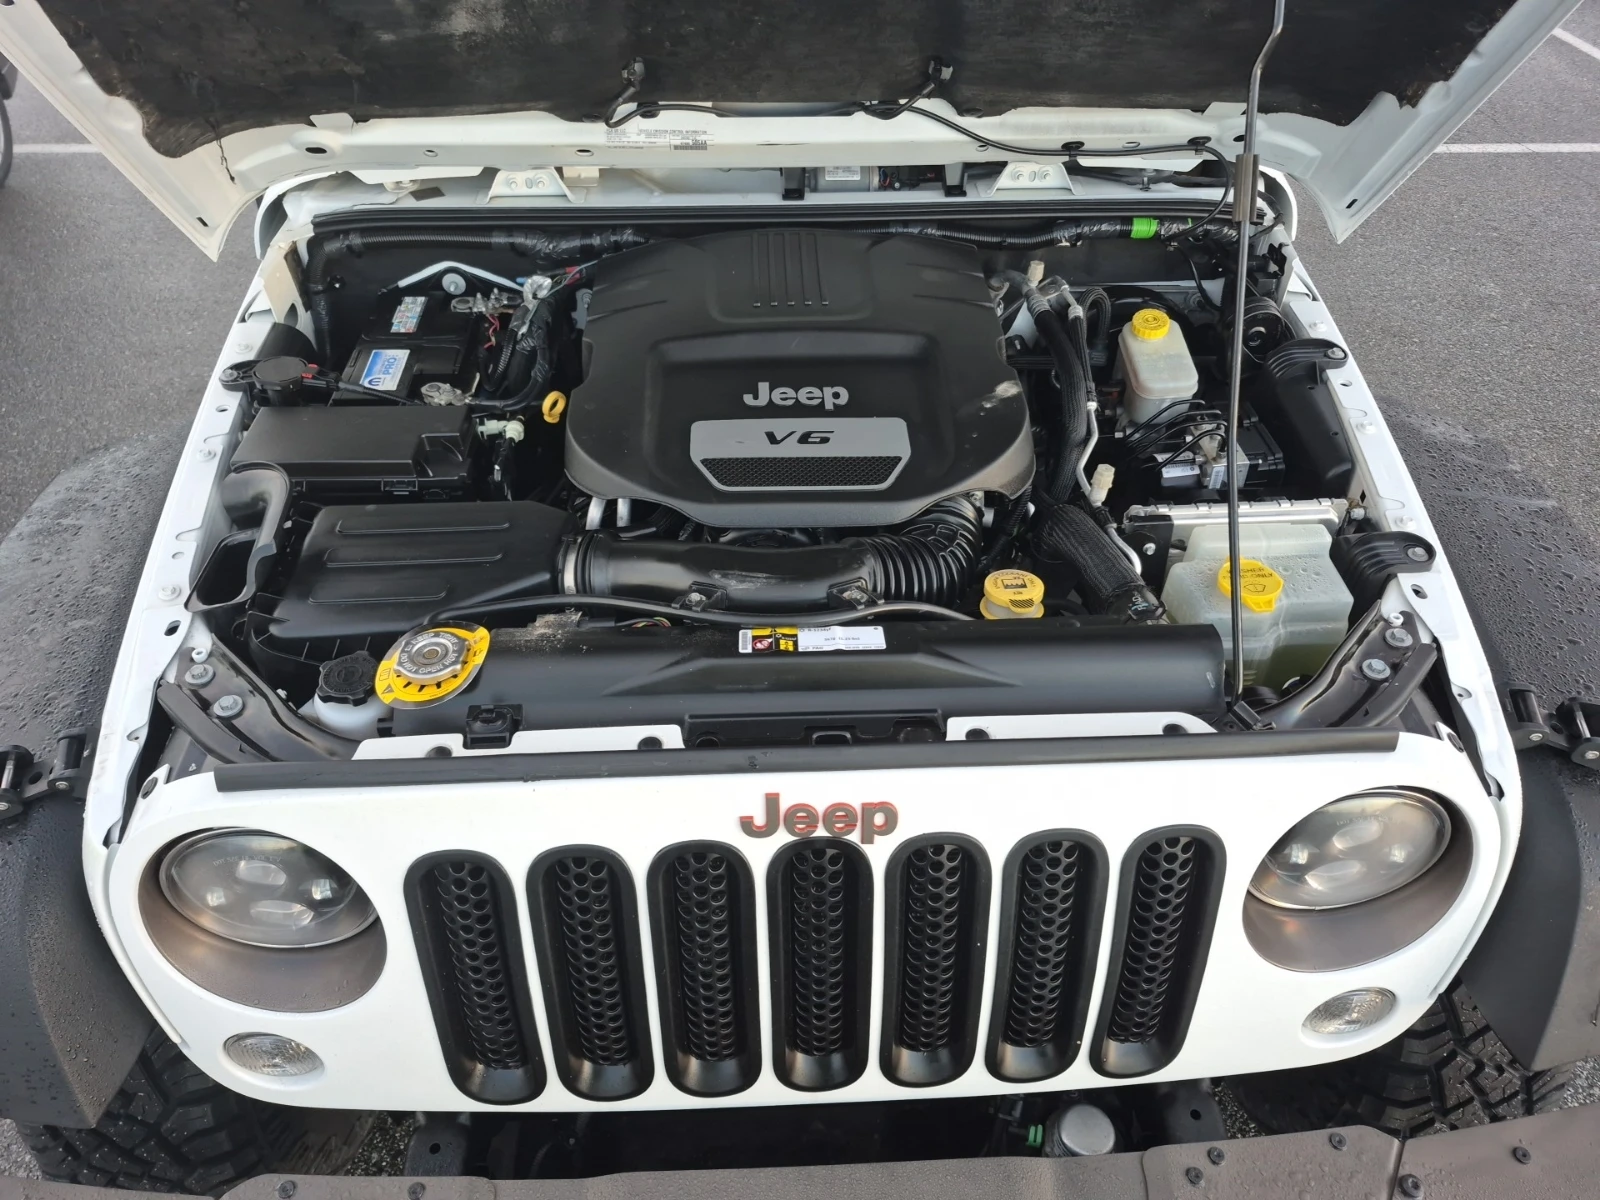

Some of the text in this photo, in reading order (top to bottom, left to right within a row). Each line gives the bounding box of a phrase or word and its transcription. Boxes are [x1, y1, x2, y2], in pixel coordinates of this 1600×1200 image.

[382, 357, 397, 375] PRO
[743, 381, 849, 411] Jeep
[764, 430, 835, 445] V6
[418, 663, 445, 674] OPEN
[443, 653, 459, 666] HOT
[739, 792, 899, 845] Jeep
